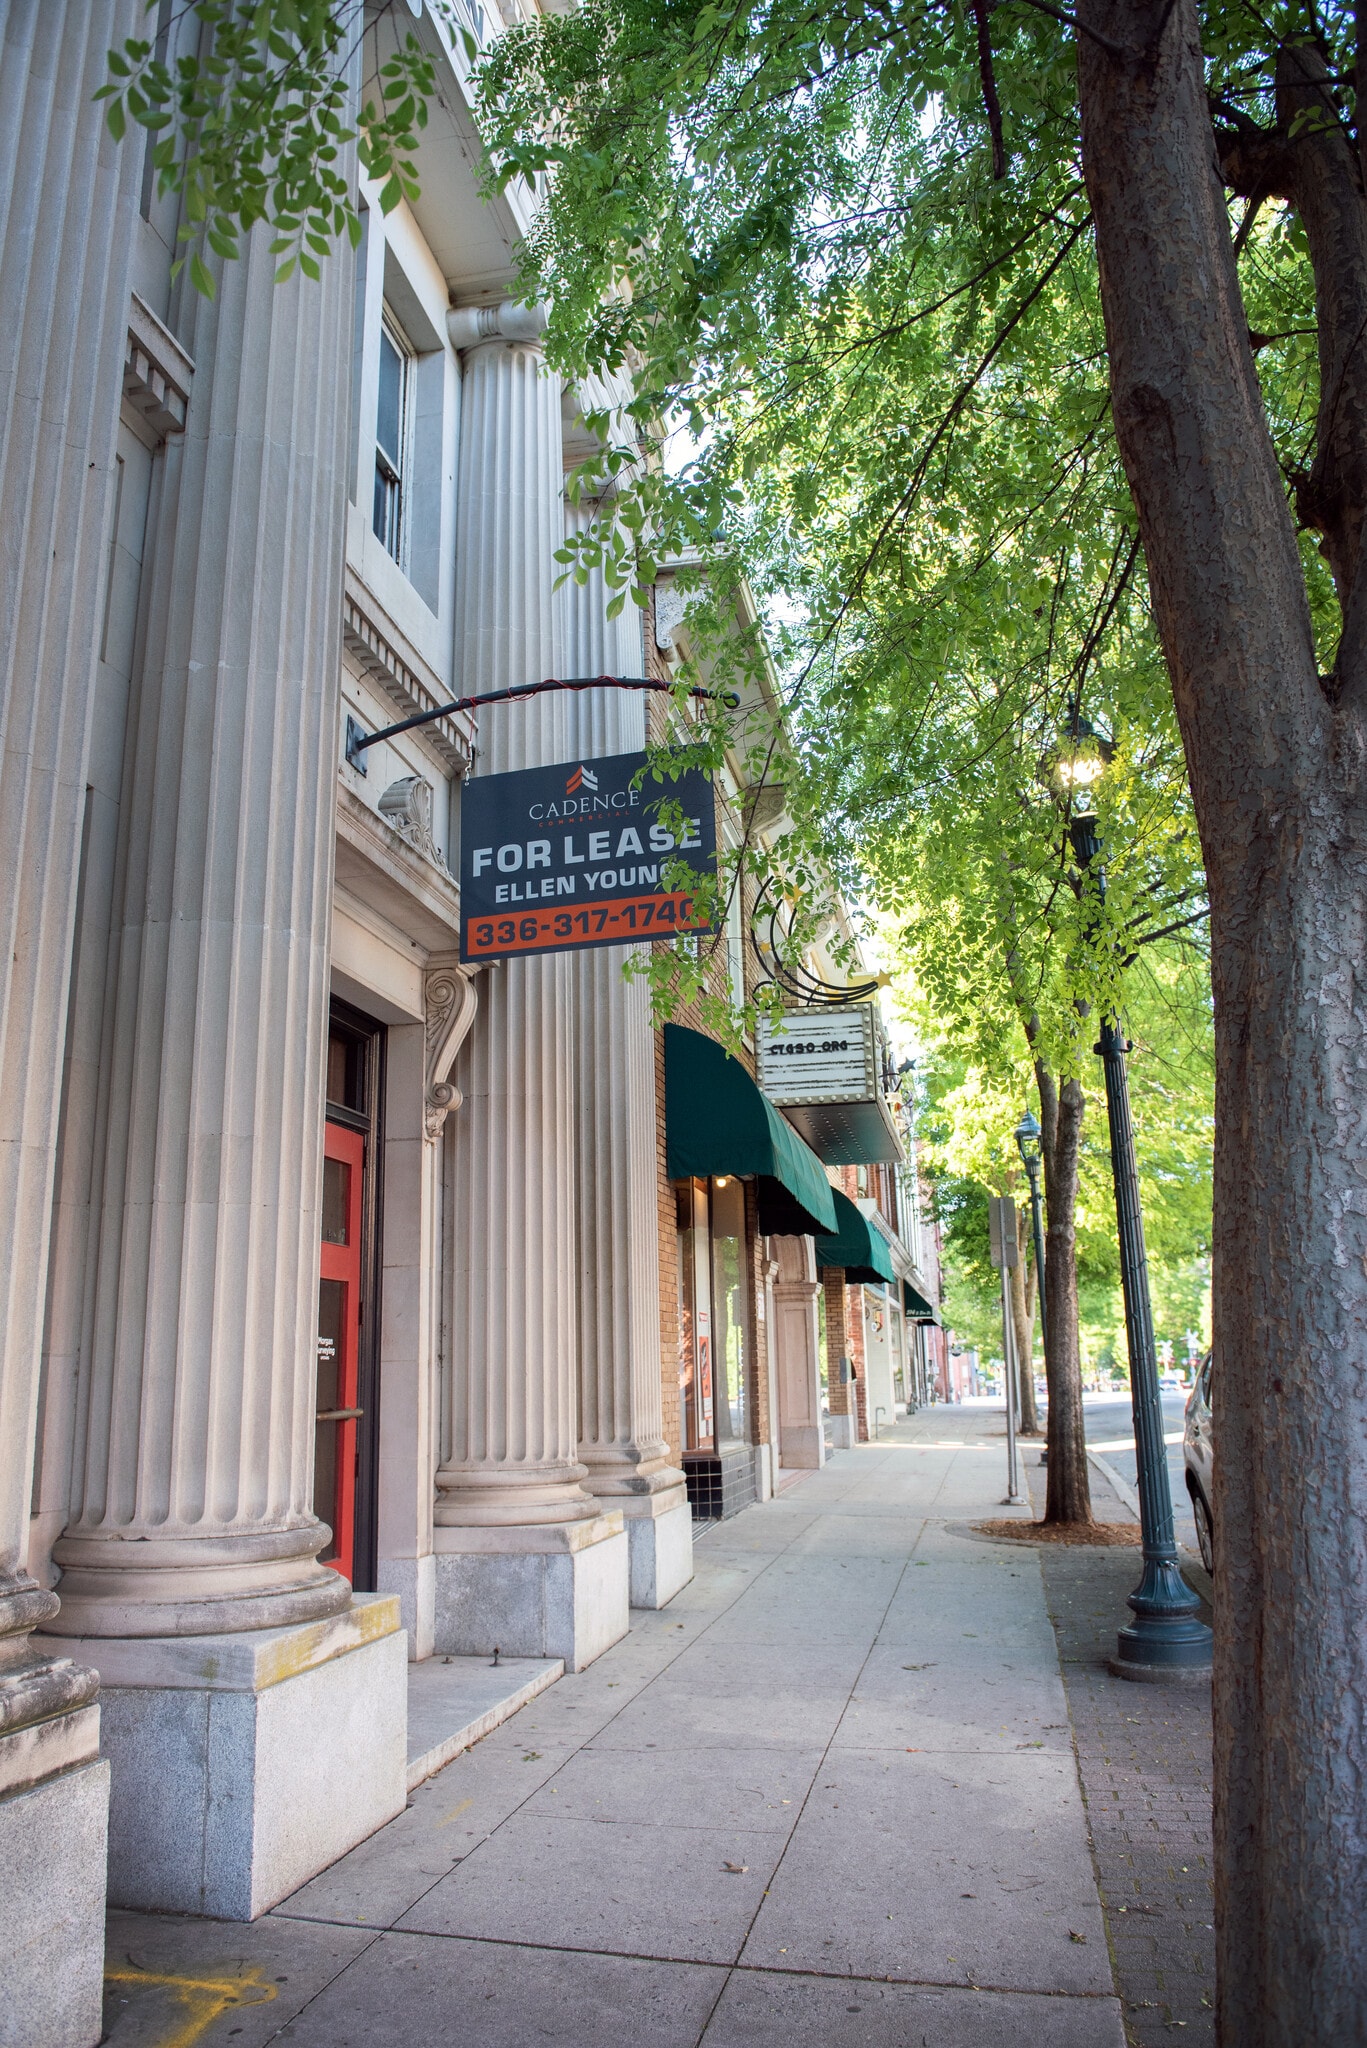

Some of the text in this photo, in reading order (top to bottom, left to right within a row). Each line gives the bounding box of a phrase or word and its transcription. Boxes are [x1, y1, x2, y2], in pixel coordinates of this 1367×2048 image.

[529, 790, 640, 820] CADENCE
[539, 810, 630, 827] COMMERCIAL
[472, 818, 702, 878] FOR LEASE
[495, 875, 575, 904] ELLEN
